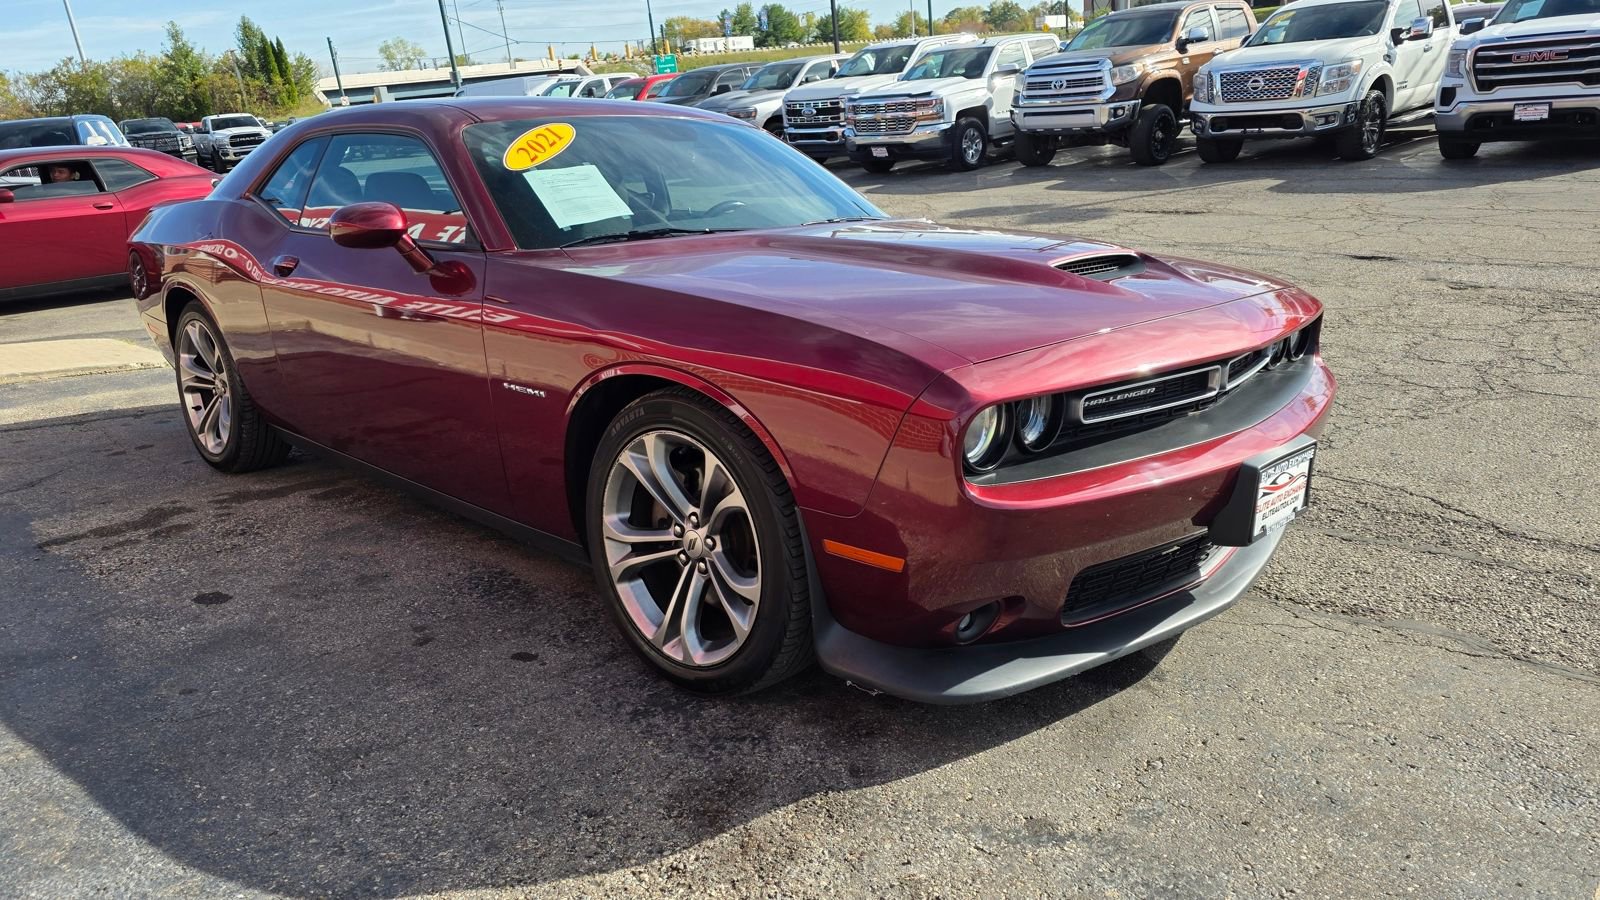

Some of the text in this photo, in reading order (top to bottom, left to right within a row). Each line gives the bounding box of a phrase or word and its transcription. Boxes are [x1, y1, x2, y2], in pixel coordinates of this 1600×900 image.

[1511, 48, 1569, 63] GMC
[516, 127, 565, 163] 2021
[503, 382, 547, 398] HEMI
[1084, 386, 1156, 408] HALLENGER
[1255, 480, 1307, 514] ELITE AUTO EXCHANGE
